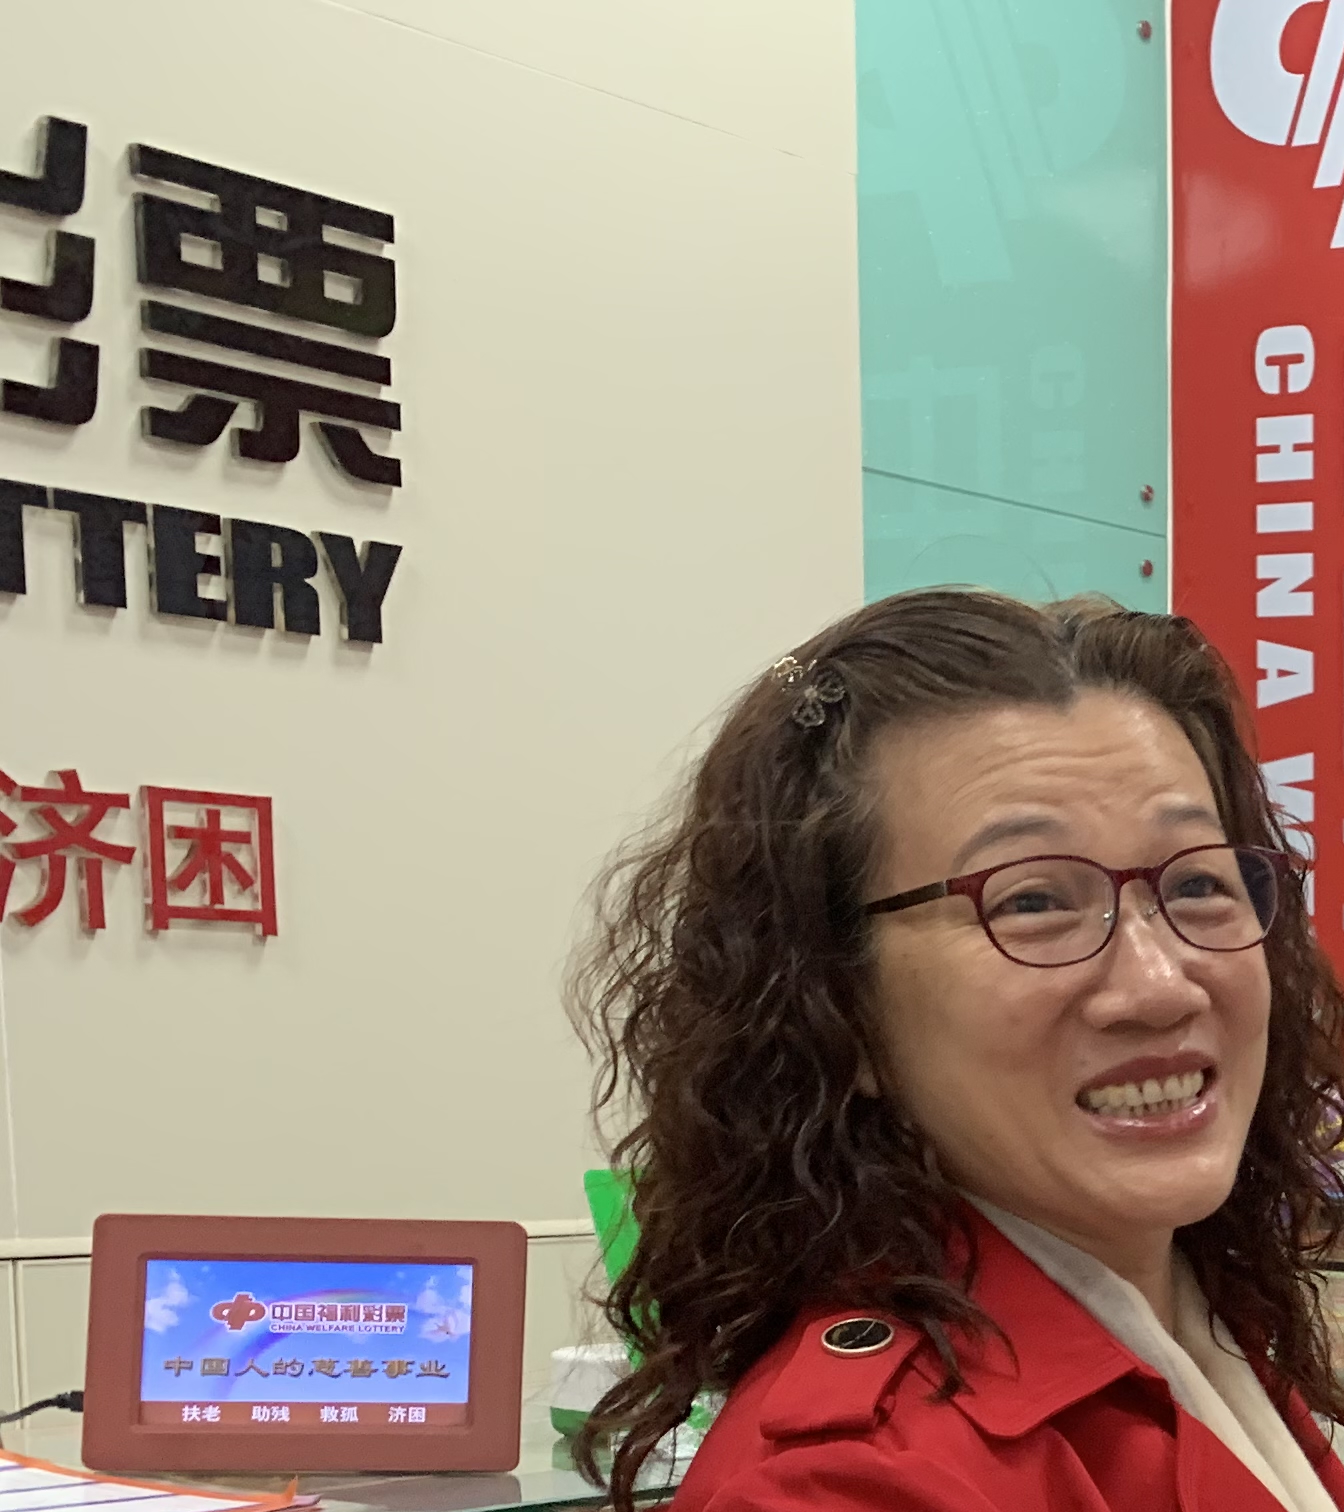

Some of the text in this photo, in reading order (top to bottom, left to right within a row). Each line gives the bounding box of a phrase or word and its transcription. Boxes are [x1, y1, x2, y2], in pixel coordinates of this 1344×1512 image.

[1254, 324, 1315, 709] CHINA
[270, 1302, 409, 1324] 中国福利彩票
[270, 1323, 405, 1334] CHINA WELFARE LOTTERY
[162, 1355, 451, 1379] 中国人的慈善事业
[182, 1405, 426, 1423] 扶老 助残 救孤 济困
